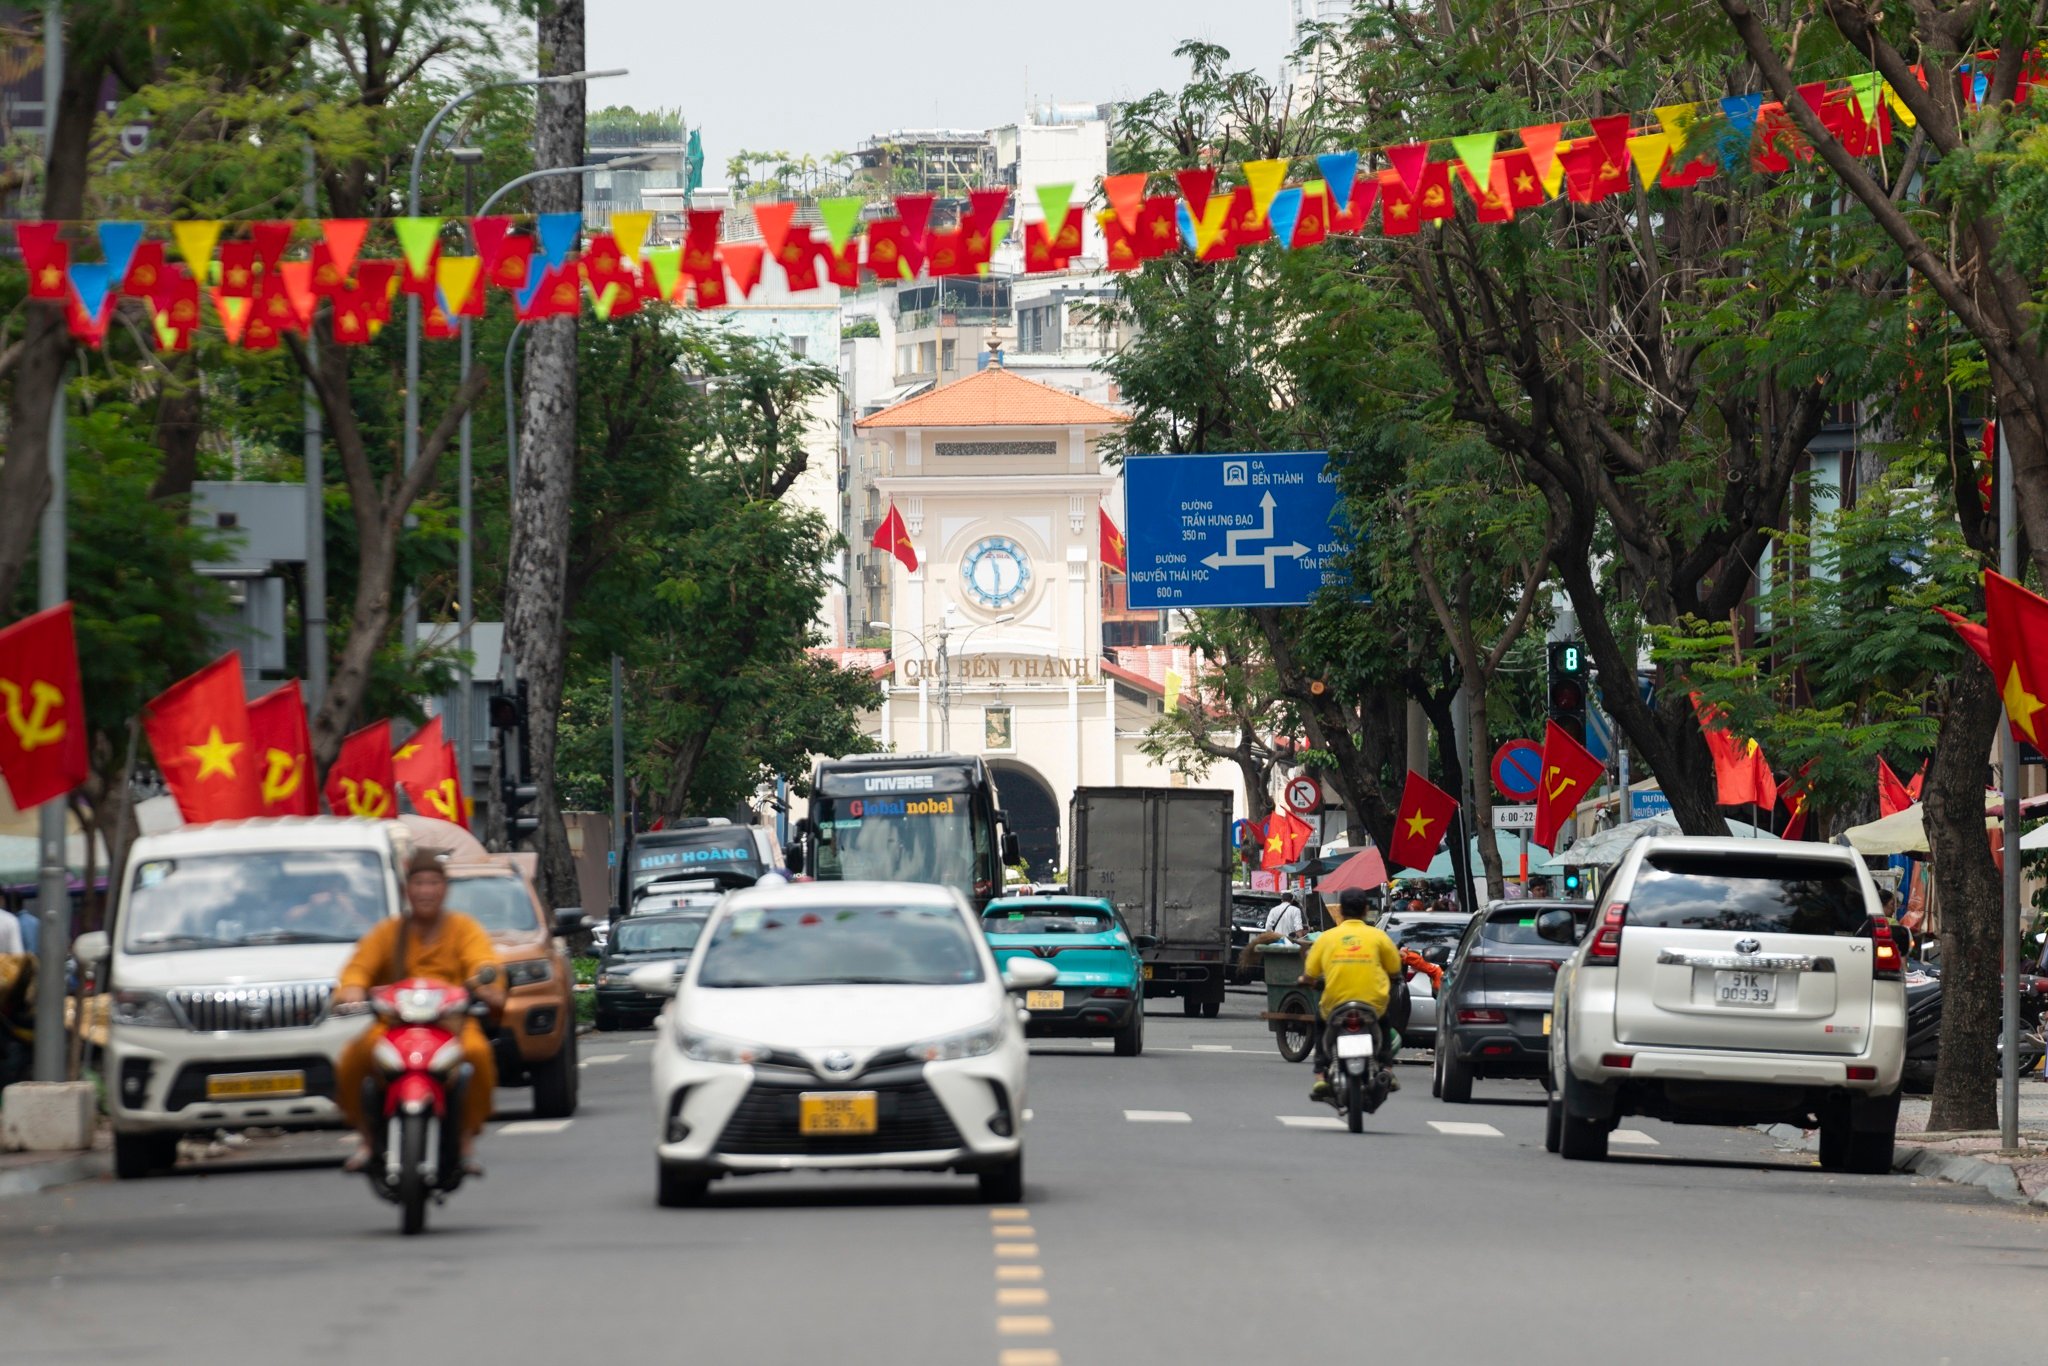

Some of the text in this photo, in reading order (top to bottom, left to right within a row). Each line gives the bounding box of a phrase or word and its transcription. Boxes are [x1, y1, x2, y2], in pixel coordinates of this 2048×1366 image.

[1252, 461, 1264, 470] GA
[1252, 469, 1271, 485] BẾN
[1272, 469, 1304, 485] THÀNH
[1181, 499, 1213, 511] ĐƯỜNG
[1181, 511, 1254, 528] TRẦN HƯNG ĐẠO
[1182, 530, 1206, 541] 350 m
[1155, 552, 1187, 564] ĐƯỜNG
[1298, 555, 1317, 569] TÔN
[1131, 566, 1210, 583] NGUYỄN THÁI HỌC
[1156, 586, 1182, 598] 600 m
[957, 652, 1000, 678] BẾN
[1009, 654, 1090, 678] THÀNH
[1566, 648, 1578, 670] 8
[864, 775, 934, 791] UNIVERSE
[1642, 794, 1669, 803] ĐƯỜN
[850, 797, 954, 817] Global nobel
[640, 847, 749, 868] HUY HOÀNG
[1733, 973, 1759, 987] 51K
[1722, 987, 1769, 1001] 009.39
